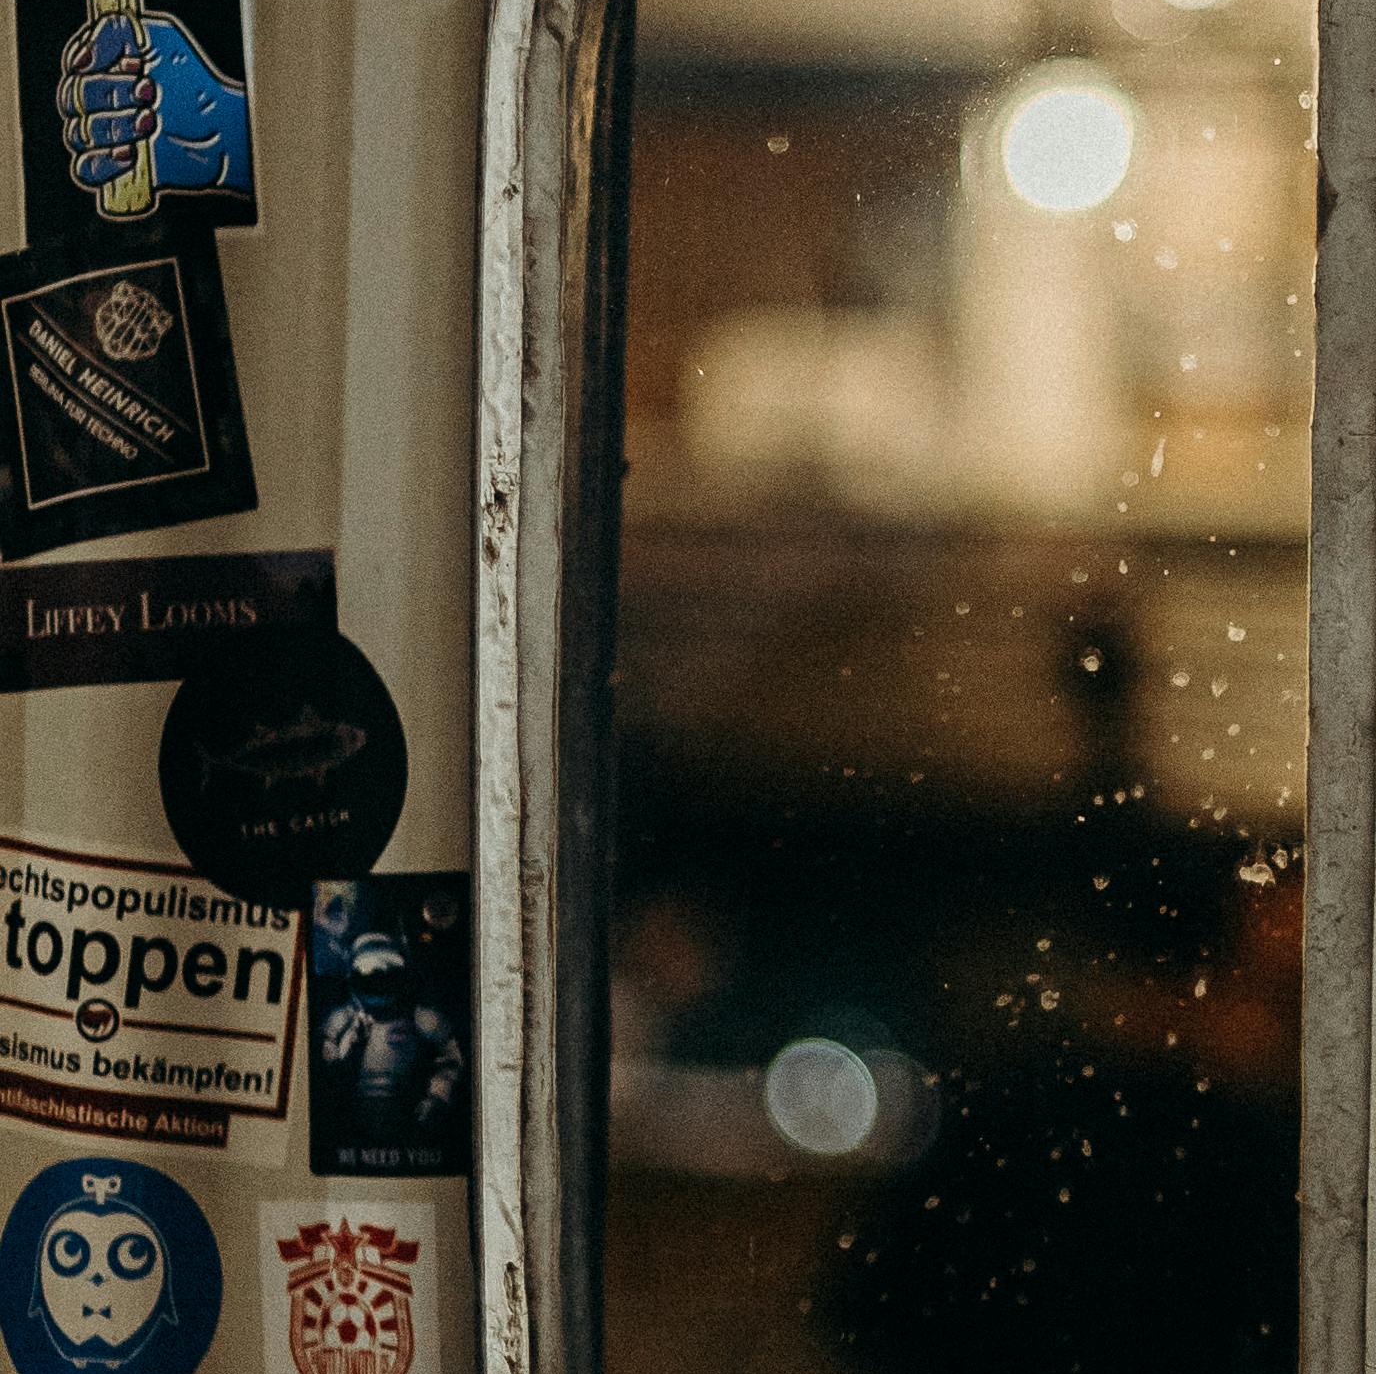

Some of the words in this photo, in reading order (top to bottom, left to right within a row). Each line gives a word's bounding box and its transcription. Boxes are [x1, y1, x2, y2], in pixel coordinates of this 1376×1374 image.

[28, 318, 79, 377] DANIEL
[77, 366, 176, 444] HEINRICH
[4, 898, 286, 1010] toppen
[92, 1048, 275, 1095] bekämpfen!
[153, 1113, 226, 1138] Aktion
